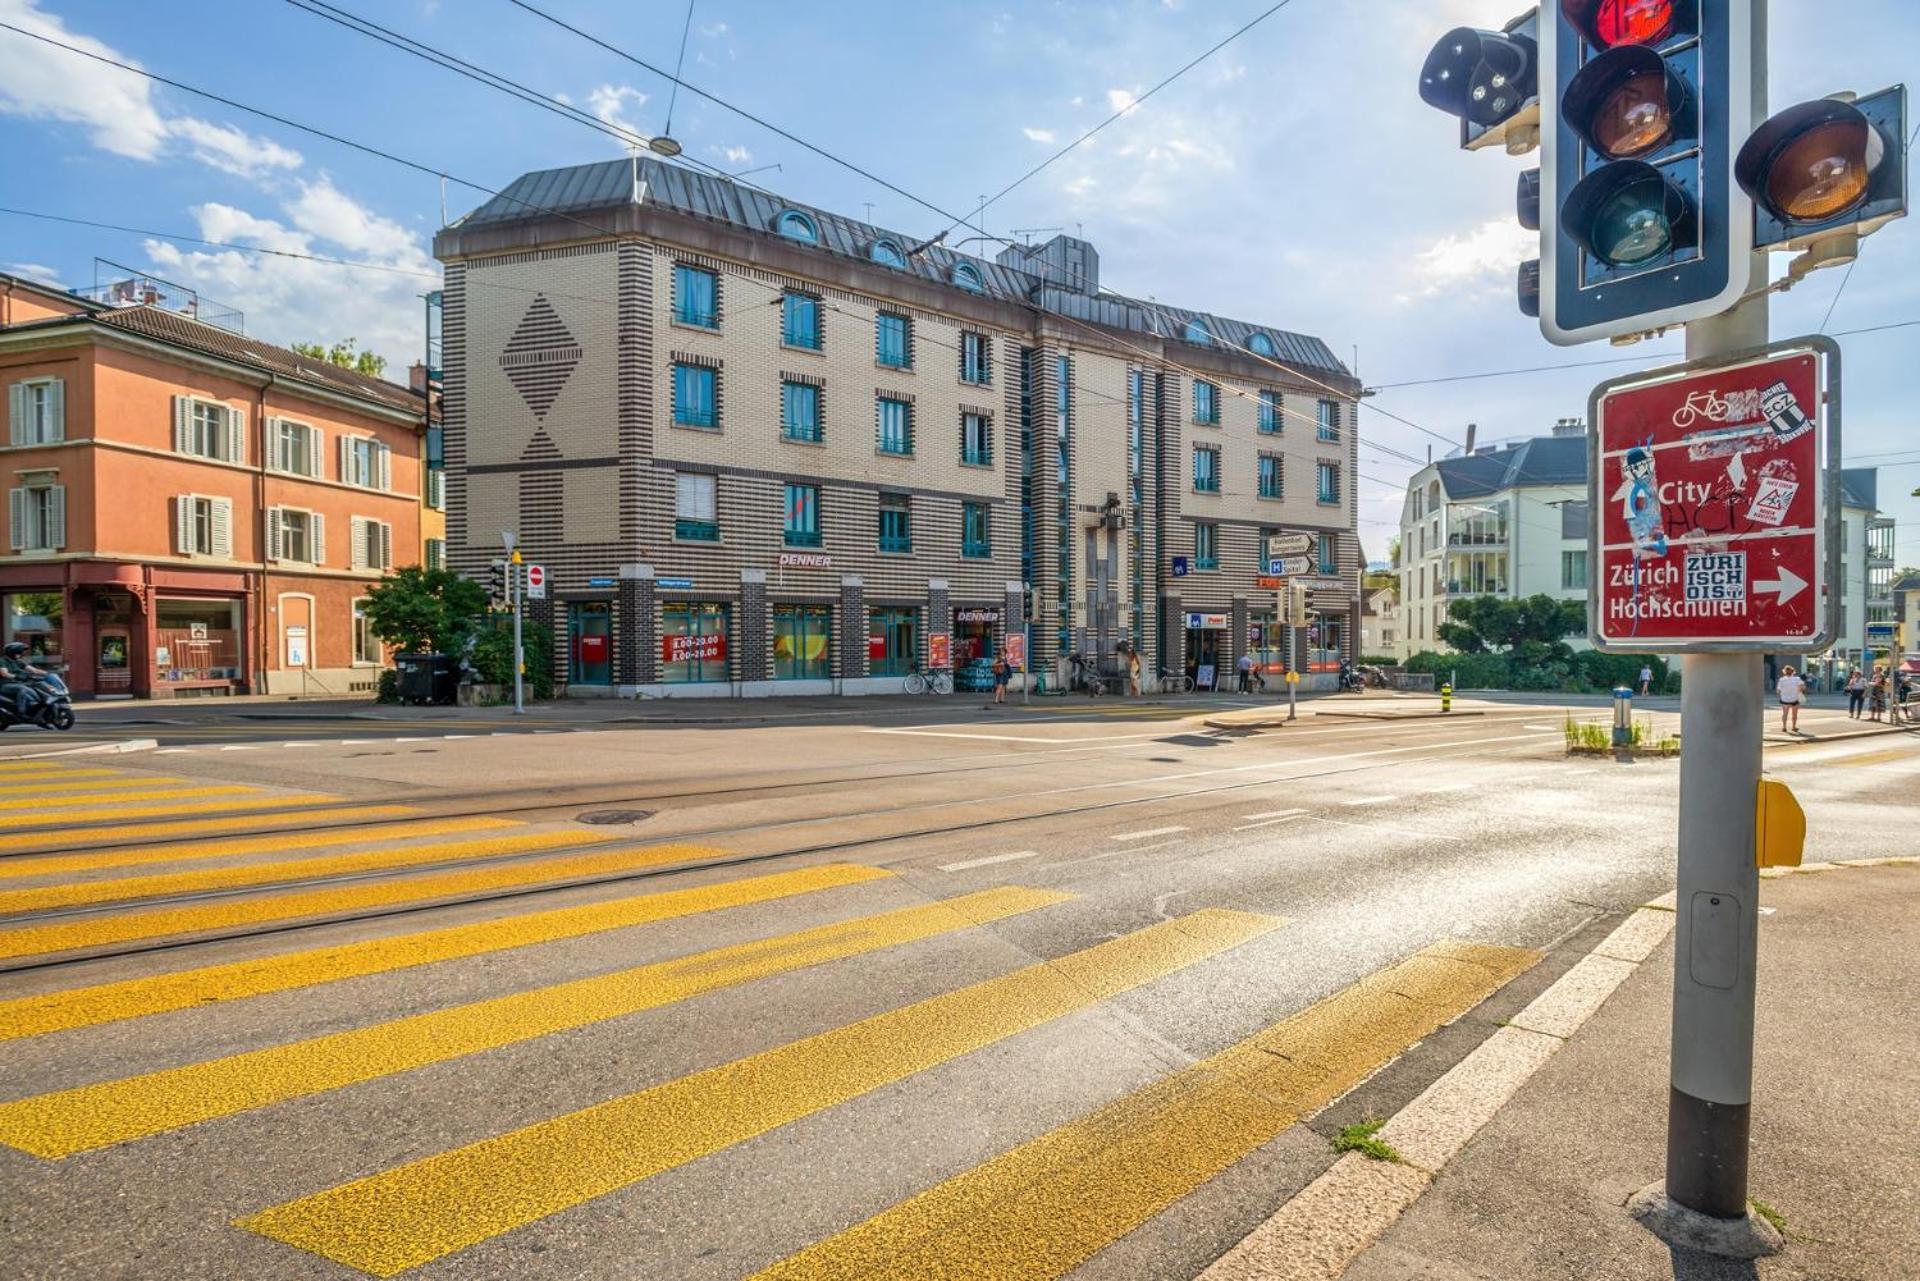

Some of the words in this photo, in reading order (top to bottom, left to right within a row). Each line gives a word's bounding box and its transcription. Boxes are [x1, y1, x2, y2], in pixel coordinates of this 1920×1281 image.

[1764, 394, 1793, 418] FCZ
[1658, 480, 1712, 507] City
[779, 554, 831, 567] DENNER
[1687, 552, 1742, 570] ZÜRI
[1610, 560, 1679, 587] Zürich
[1687, 570, 1742, 586] ISCH
[1687, 585, 1725, 599] OIS
[957, 612, 999, 622] DENNER
[1610, 598, 1747, 620] Hochschulen
